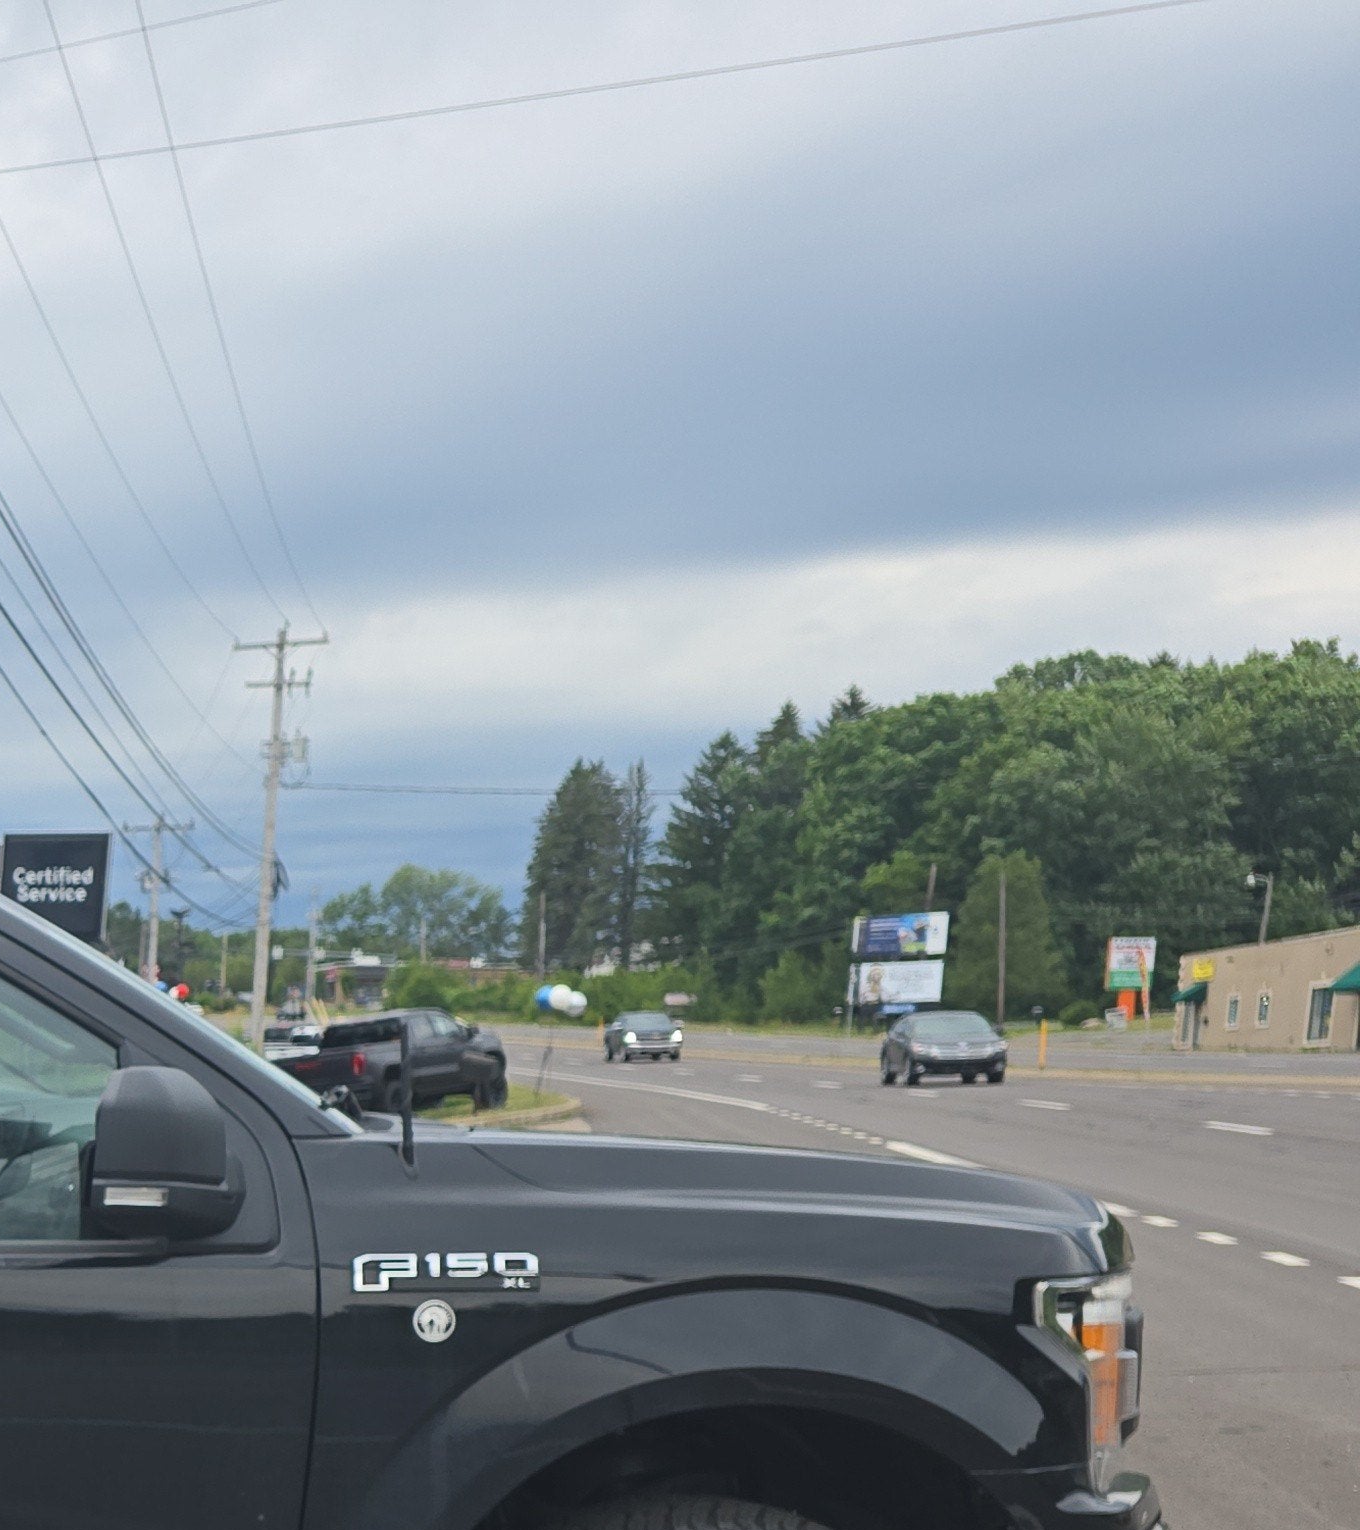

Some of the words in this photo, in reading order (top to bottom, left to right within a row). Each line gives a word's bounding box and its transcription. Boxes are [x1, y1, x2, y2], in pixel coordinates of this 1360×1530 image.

[12, 866, 94, 886] Certified
[17, 884, 87, 902] Service
[353, 1252, 539, 1292] F150
[502, 1277, 530, 1289] XL
